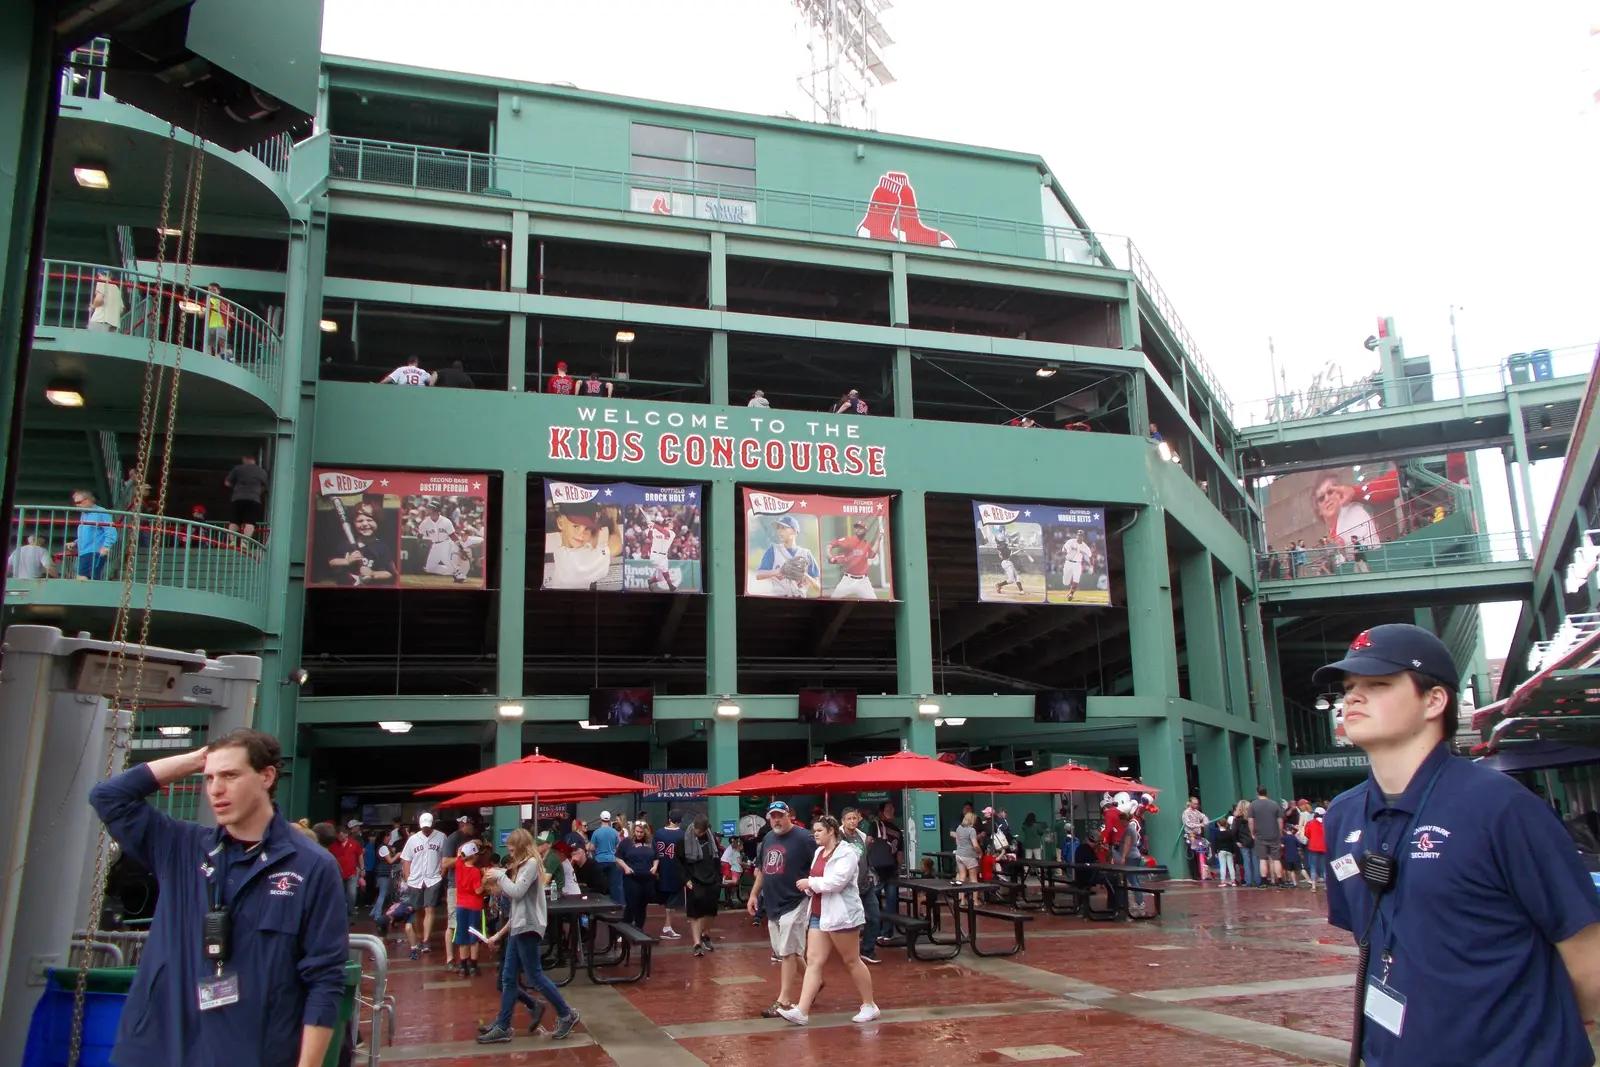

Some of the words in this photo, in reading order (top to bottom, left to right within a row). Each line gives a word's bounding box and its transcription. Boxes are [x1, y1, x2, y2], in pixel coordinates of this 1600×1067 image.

[406, 375, 419, 385] 18
[578, 407, 728, 429] WELCOME
[751, 418, 785, 433] TO
[806, 422, 860, 438] THE
[548, 426, 645, 462] KIDS
[657, 432, 887, 478] CONCOURSE
[336, 475, 352, 491] RED
[353, 479, 368, 490] SOX
[420, 483, 442, 491] DUSTIN
[443, 484, 469, 492] PEDROIA
[565, 485, 579, 501] RED
[580, 489, 593, 500] SOX
[645, 492, 668, 502] BROCK
[669, 493, 686, 502] HOLT
[764, 496, 777, 511] RED
[777, 501, 790, 511] SOX
[843, 505, 858, 513] DAVID
[859, 505, 874, 514] PRICE
[991, 507, 1003, 521] RED
[1003, 511, 1016, 520] SOX
[1323, 757, 1348, 768] RIGHT
[1349, 755, 1370, 767] FIEL
[1432, 825, 1452, 838] PARK
[414, 844, 424, 854] RED
[429, 843, 441, 851] SOX
[656, 841, 676, 859] 24
[1410, 851, 1441, 859] SECURITY
[269, 889, 295, 897] SECURITY
